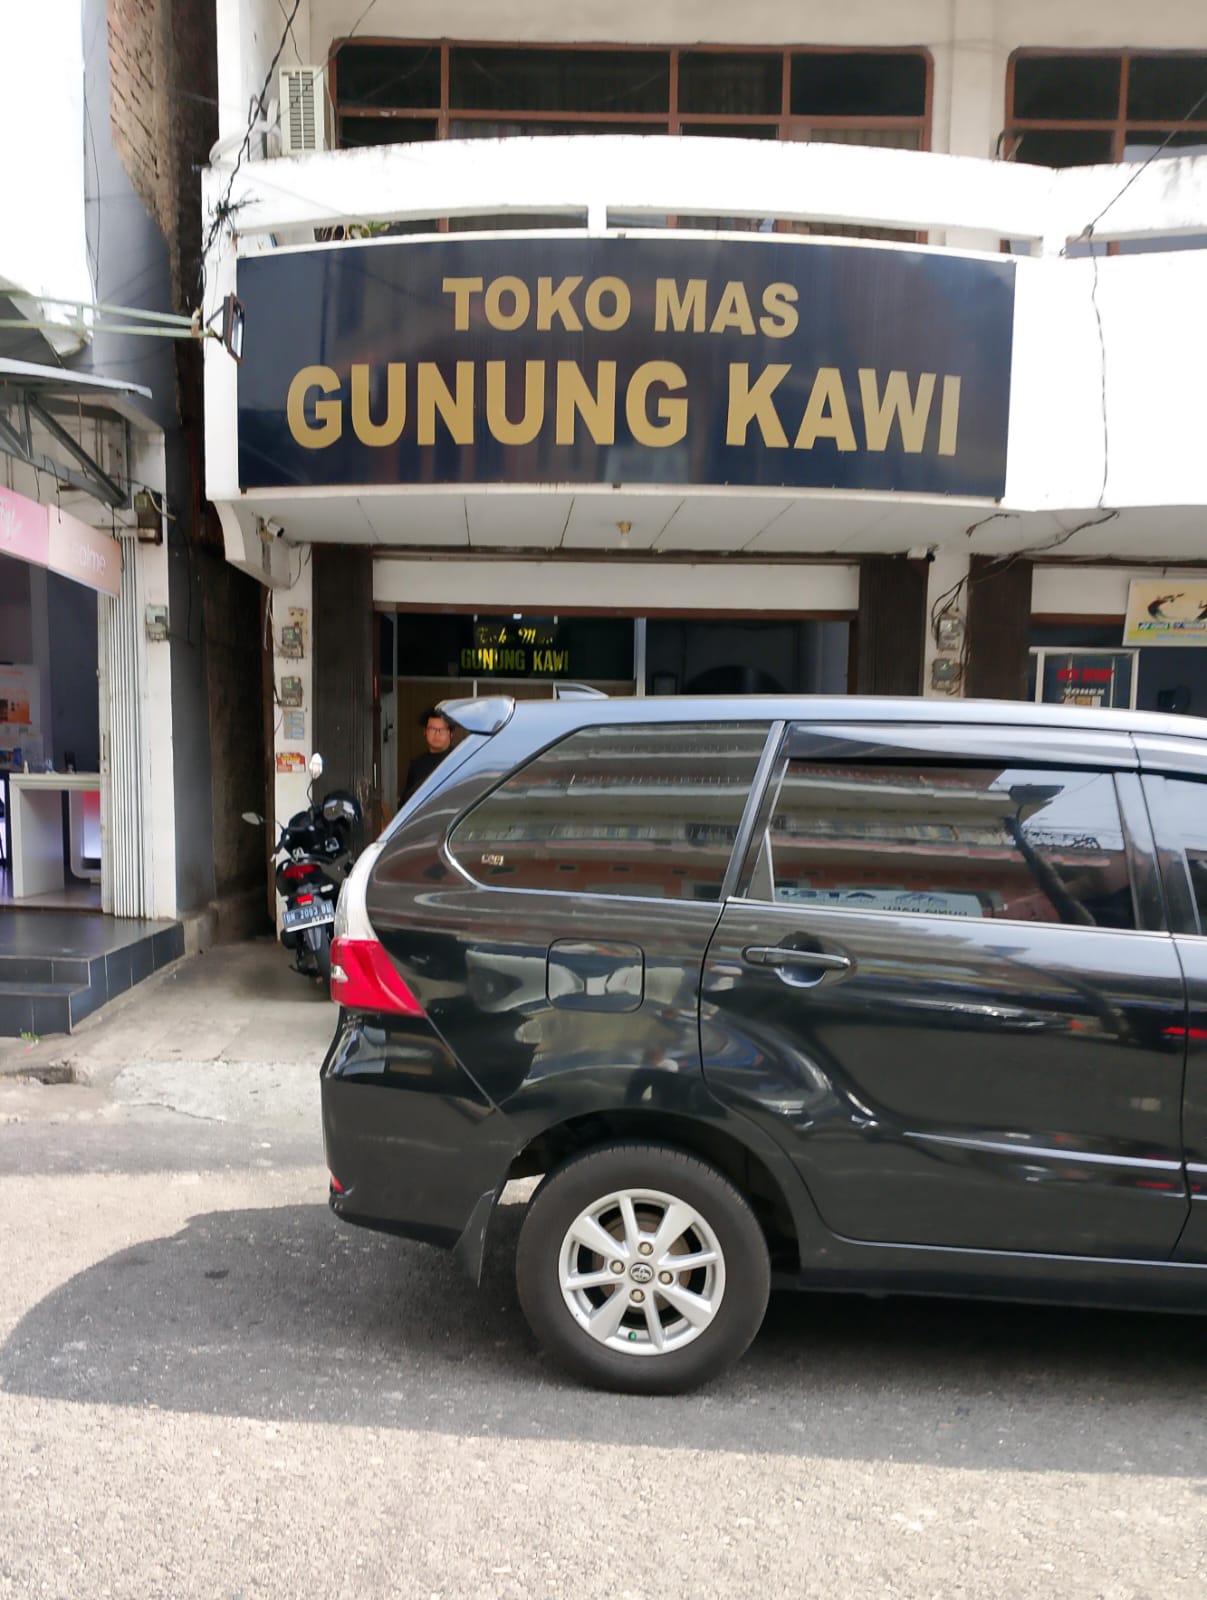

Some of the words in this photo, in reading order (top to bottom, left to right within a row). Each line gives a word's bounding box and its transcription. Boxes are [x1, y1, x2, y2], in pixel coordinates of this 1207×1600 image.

[442, 276, 632, 332] TOKO
[656, 278, 799, 338] MAS
[288, 360, 688, 450] GUNUNG
[726, 363, 961, 456] KAWI
[460, 647, 526, 671] GUNUNG
[533, 649, 569, 672] KAWI
